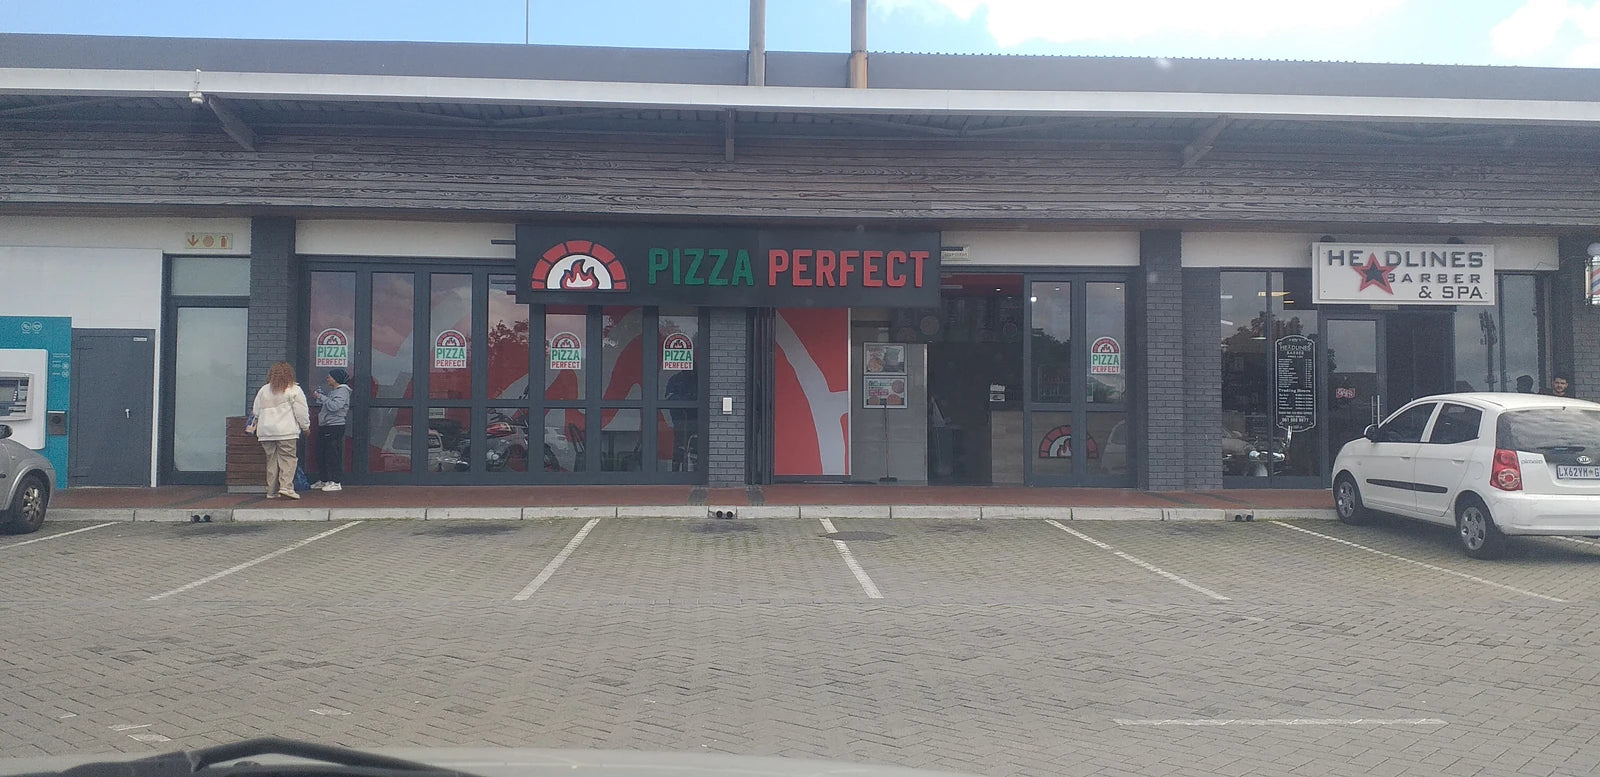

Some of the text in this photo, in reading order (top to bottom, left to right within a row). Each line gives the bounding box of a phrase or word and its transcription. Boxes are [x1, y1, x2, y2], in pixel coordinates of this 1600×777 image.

[1328, 250, 1483, 268] HEADLINES
[648, 247, 930, 288] PIZZA PERFECT
[1388, 273, 1481, 284] BARBER
[1418, 286, 1483, 299] & SPA
[317, 346, 346, 358] PIZZA
[436, 347, 465, 359] PIZZA
[551, 349, 580, 361] PIZZA
[664, 350, 692, 362] PIZZA
[551, 361, 580, 369] PERFECT
[1092, 354, 1120, 366] PIZZA
